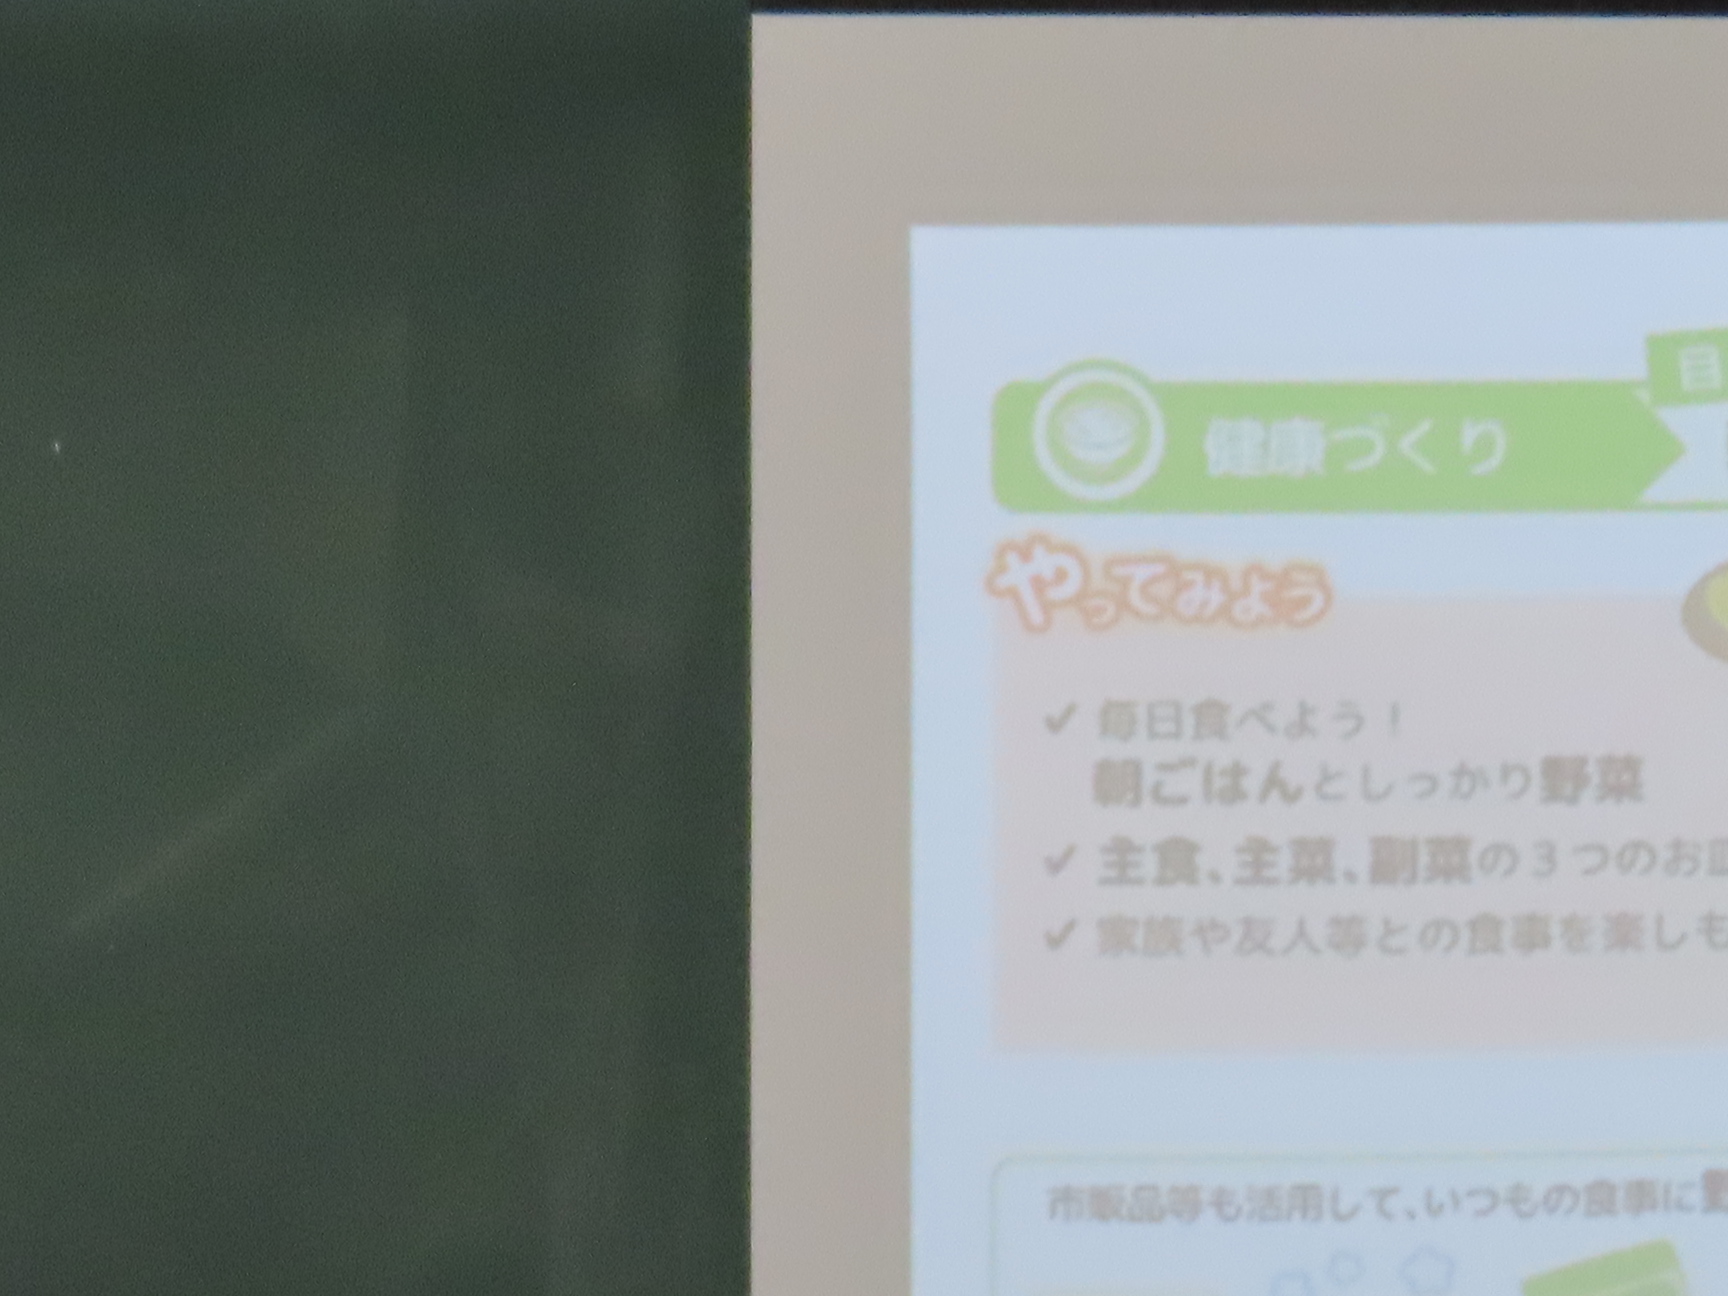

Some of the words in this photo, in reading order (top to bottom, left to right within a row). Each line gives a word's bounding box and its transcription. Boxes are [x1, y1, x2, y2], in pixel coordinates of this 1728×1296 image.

[1202, 415, 1508, 477] 健康づくり
[985, 532, 1333, 632] やってみよう
[1091, 754, 1646, 809] 朝ごはんとしっかり野菜
